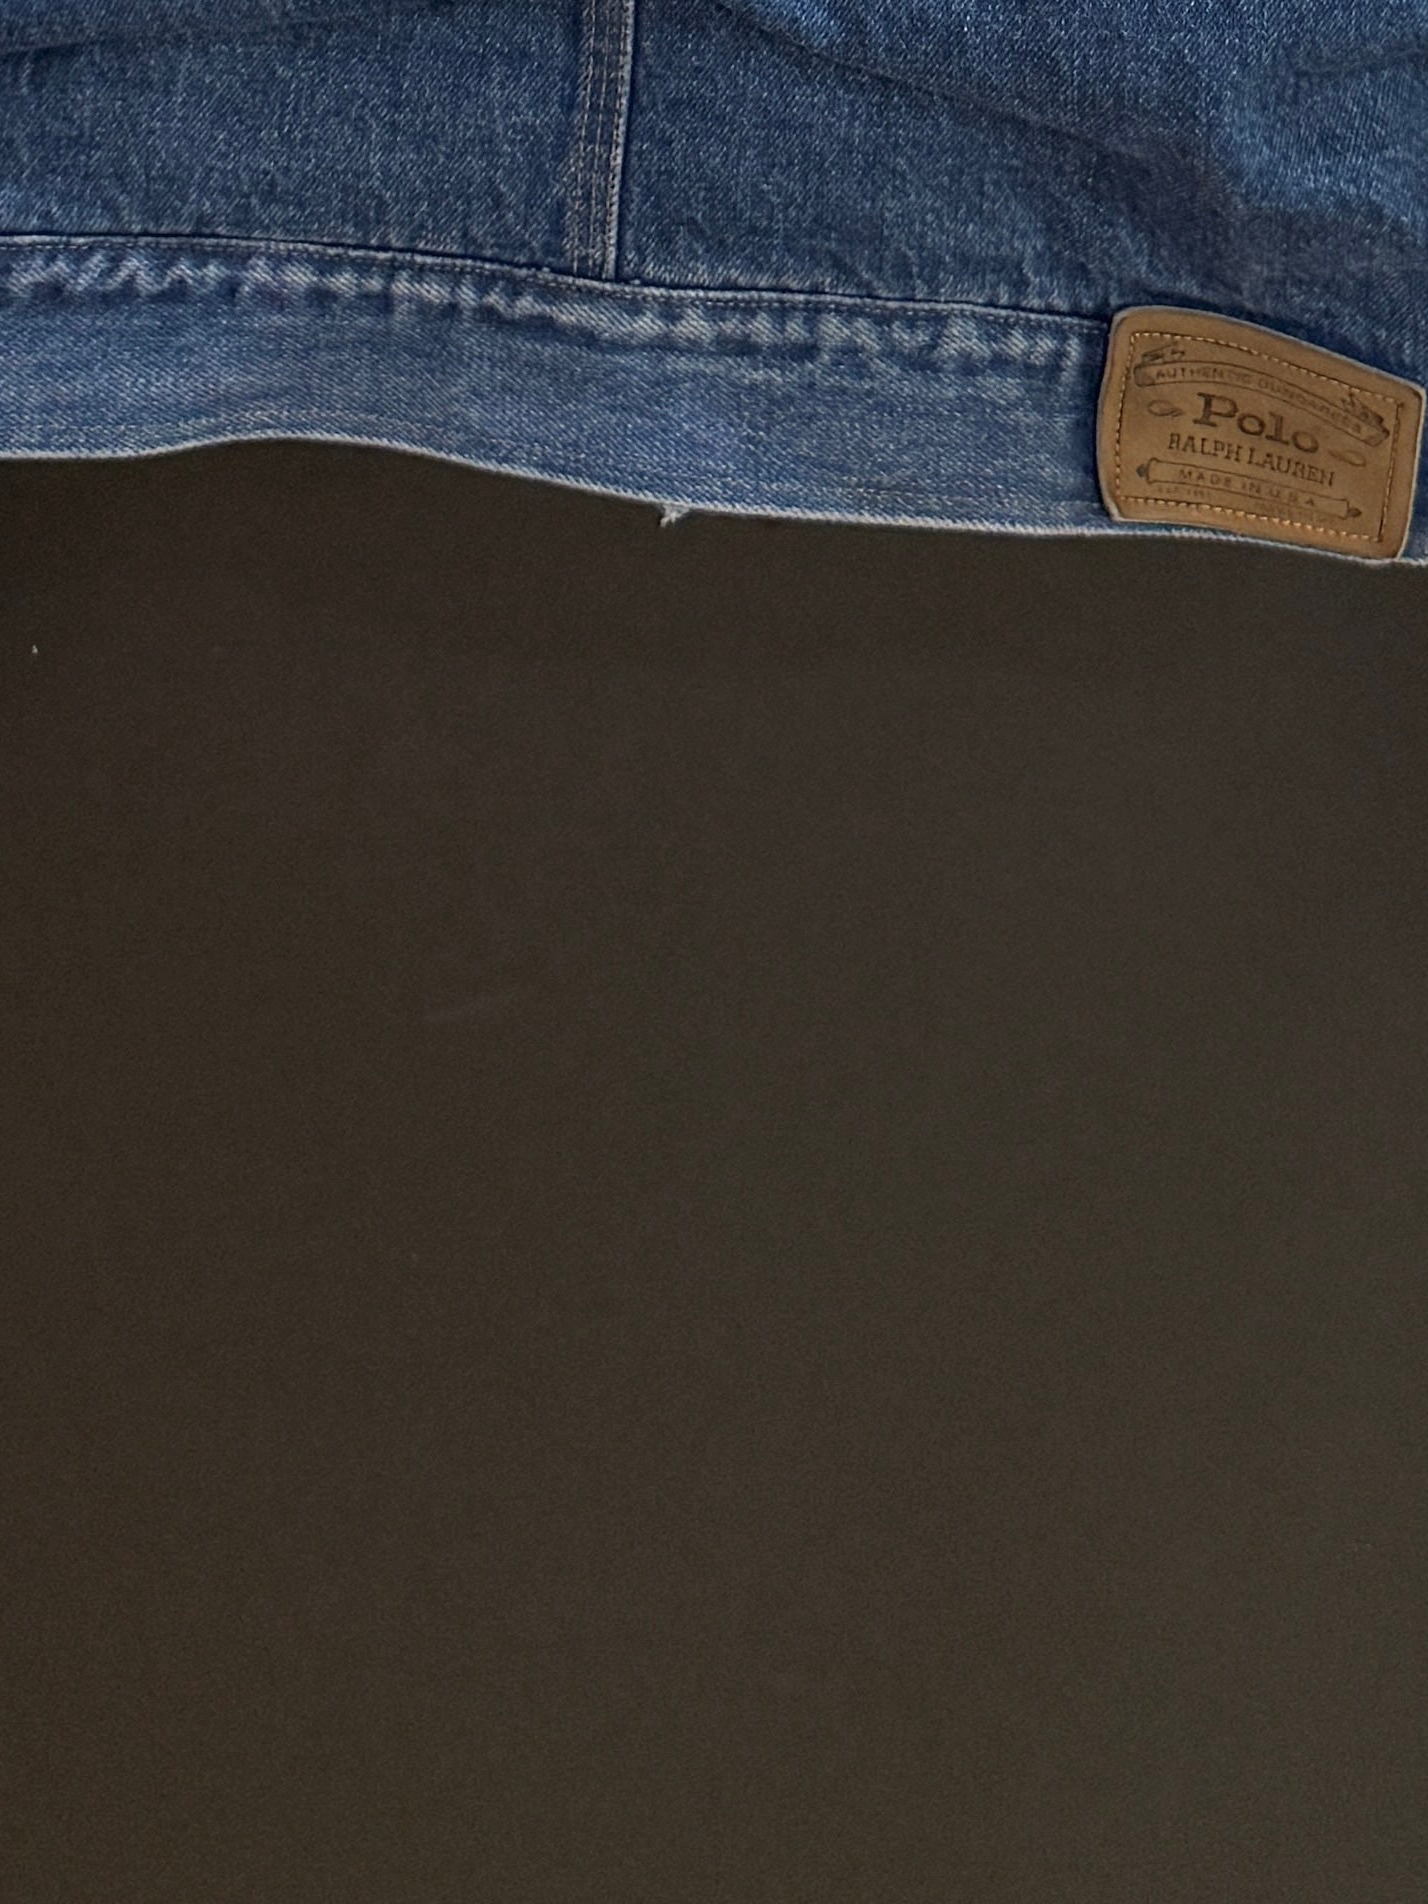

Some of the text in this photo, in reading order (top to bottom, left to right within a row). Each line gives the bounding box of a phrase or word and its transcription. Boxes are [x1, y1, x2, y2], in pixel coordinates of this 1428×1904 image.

[1193, 392, 1319, 453] Polo
[1168, 433, 1334, 487] RALPH LAUREN
[1179, 469, 1231, 486] MADE
[1242, 481, 1262, 494] IN
